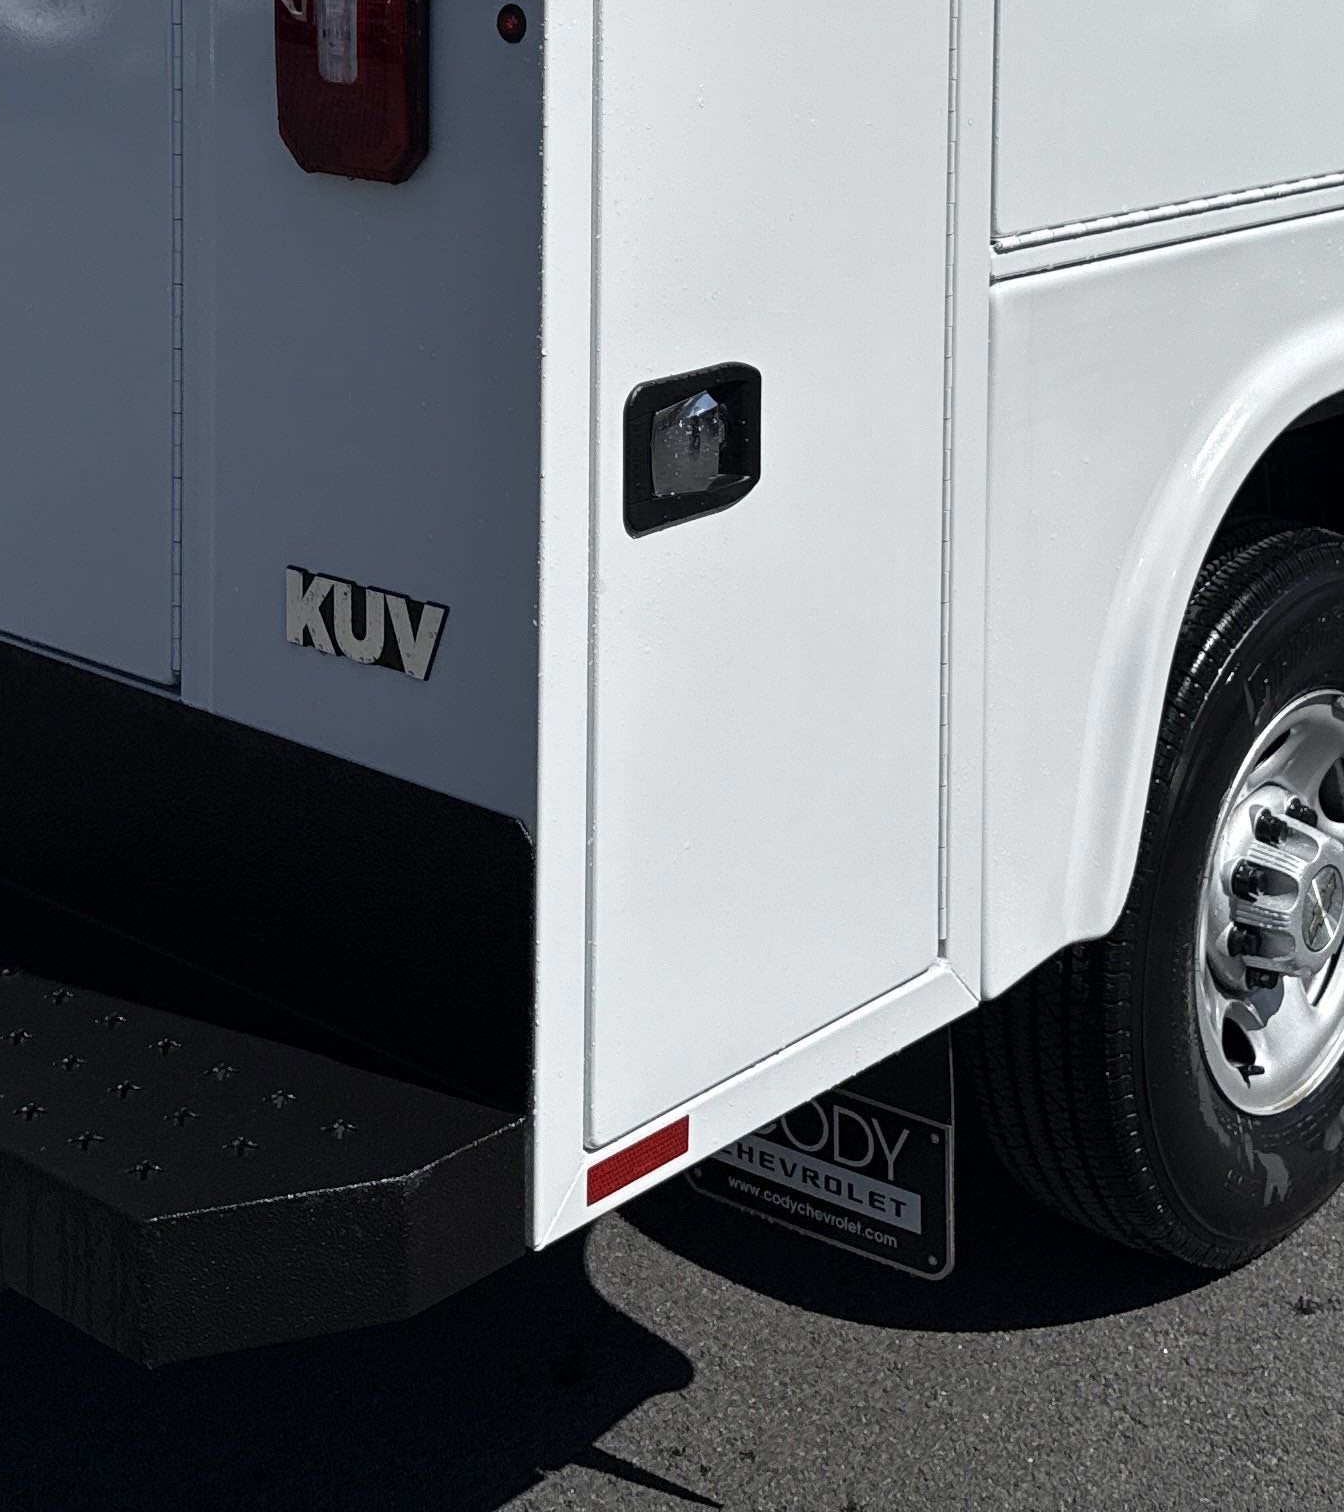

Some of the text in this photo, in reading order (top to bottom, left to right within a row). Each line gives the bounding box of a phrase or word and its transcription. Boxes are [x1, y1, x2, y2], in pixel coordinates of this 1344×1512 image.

[286, 566, 449, 681] KUV
[754, 1099, 910, 1181] ODY
[727, 1175, 899, 1248] www.codychevrolet.com
